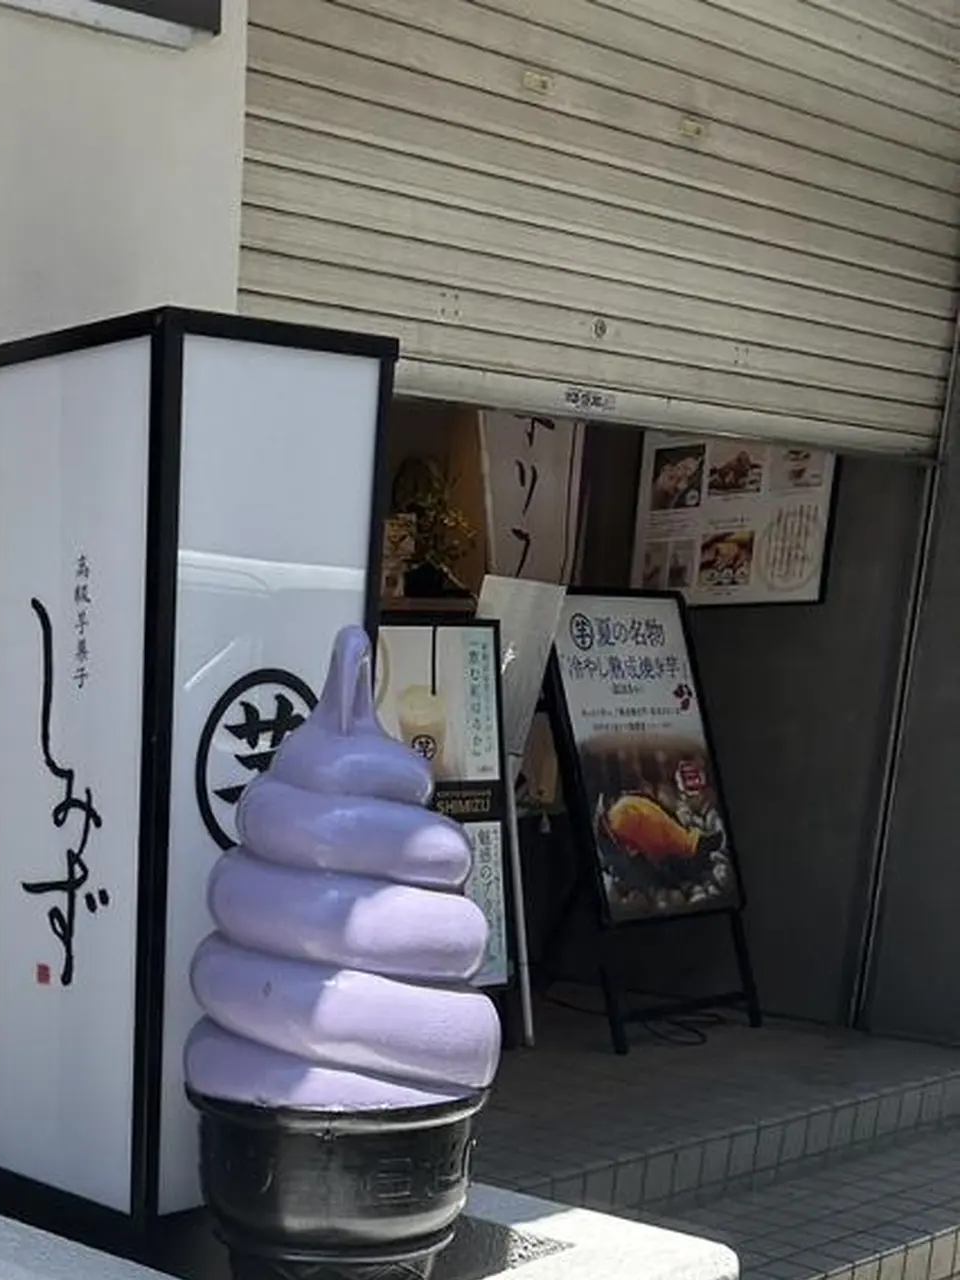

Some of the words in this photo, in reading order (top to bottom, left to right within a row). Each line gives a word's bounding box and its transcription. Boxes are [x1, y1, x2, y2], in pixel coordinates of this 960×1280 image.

[595, 616, 665, 647] 夏の名物
[21, 597, 109, 986] しみず
